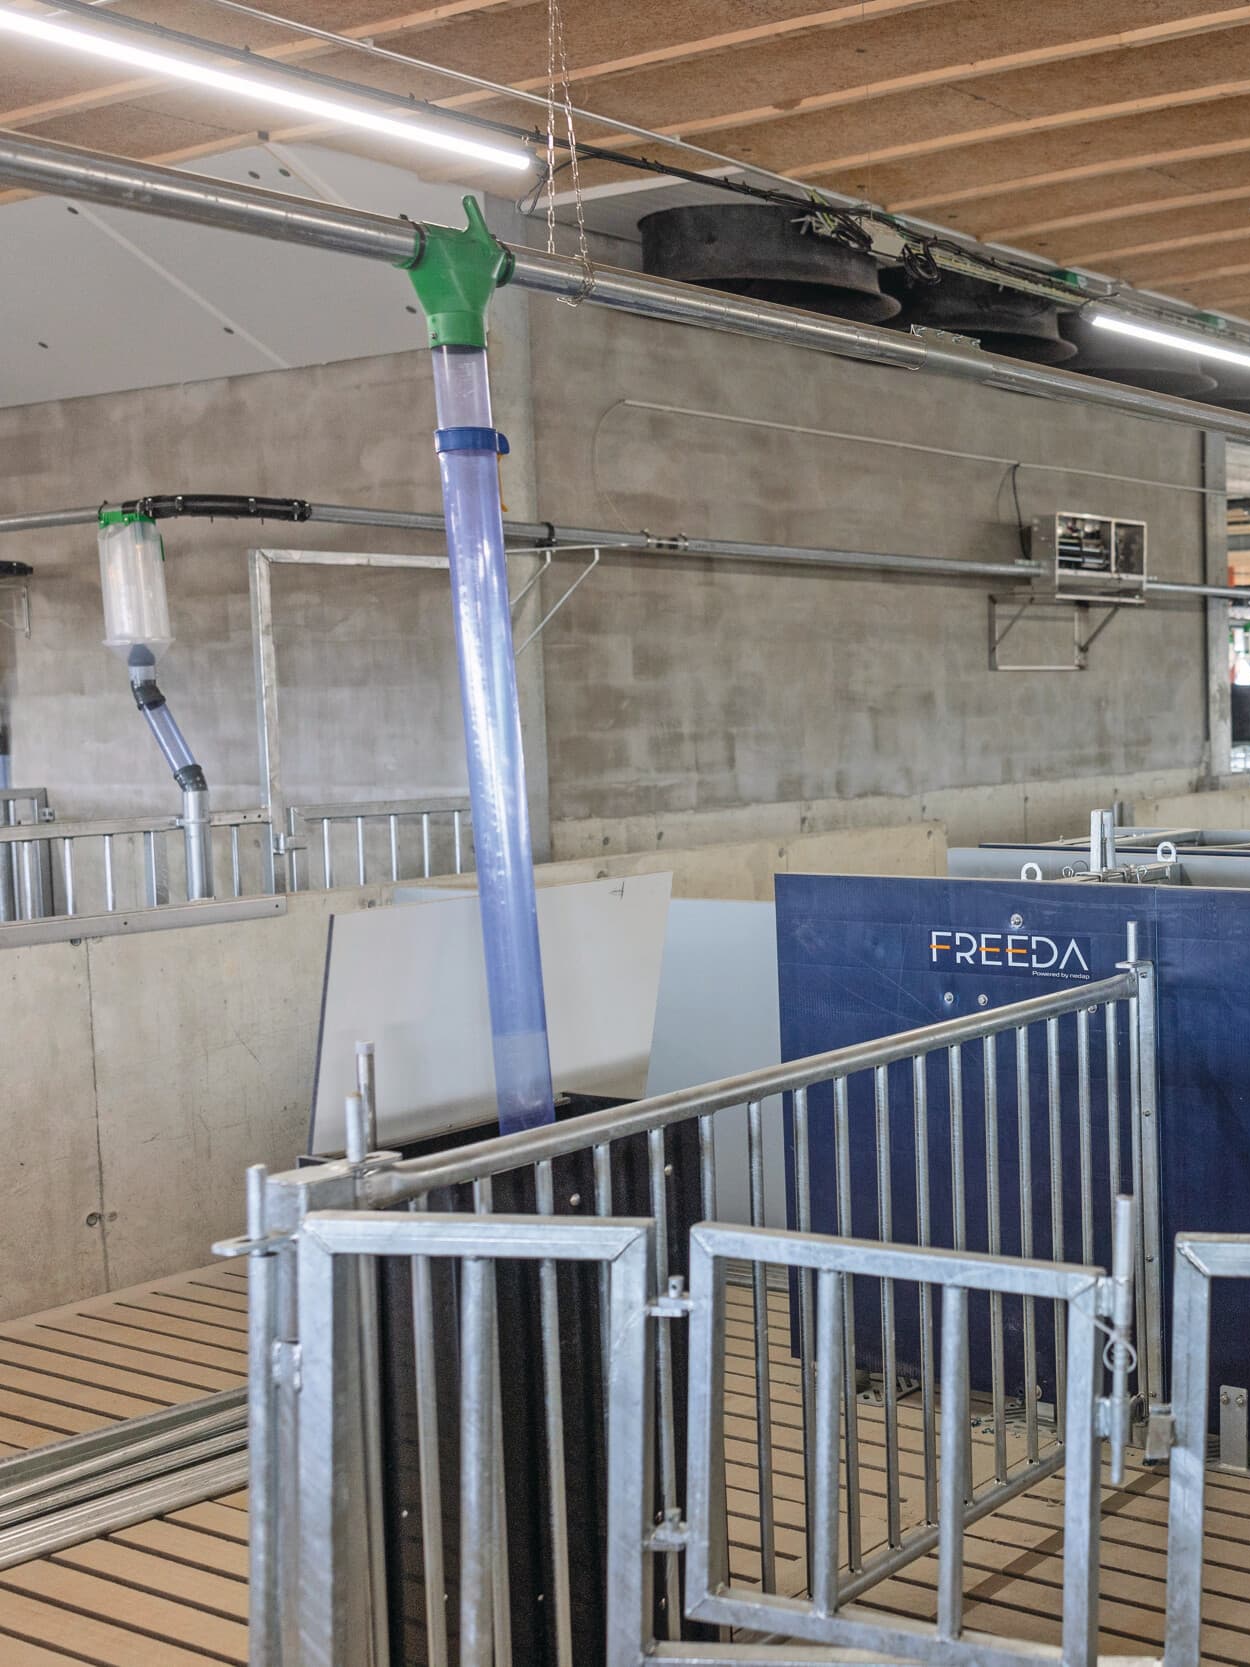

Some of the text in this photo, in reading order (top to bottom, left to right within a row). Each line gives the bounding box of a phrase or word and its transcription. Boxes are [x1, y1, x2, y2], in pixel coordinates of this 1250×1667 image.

[930, 931, 1089, 971] FREEDA
[1032, 970, 1060, 978] Powered
[1060, 971, 1069, 979] by
